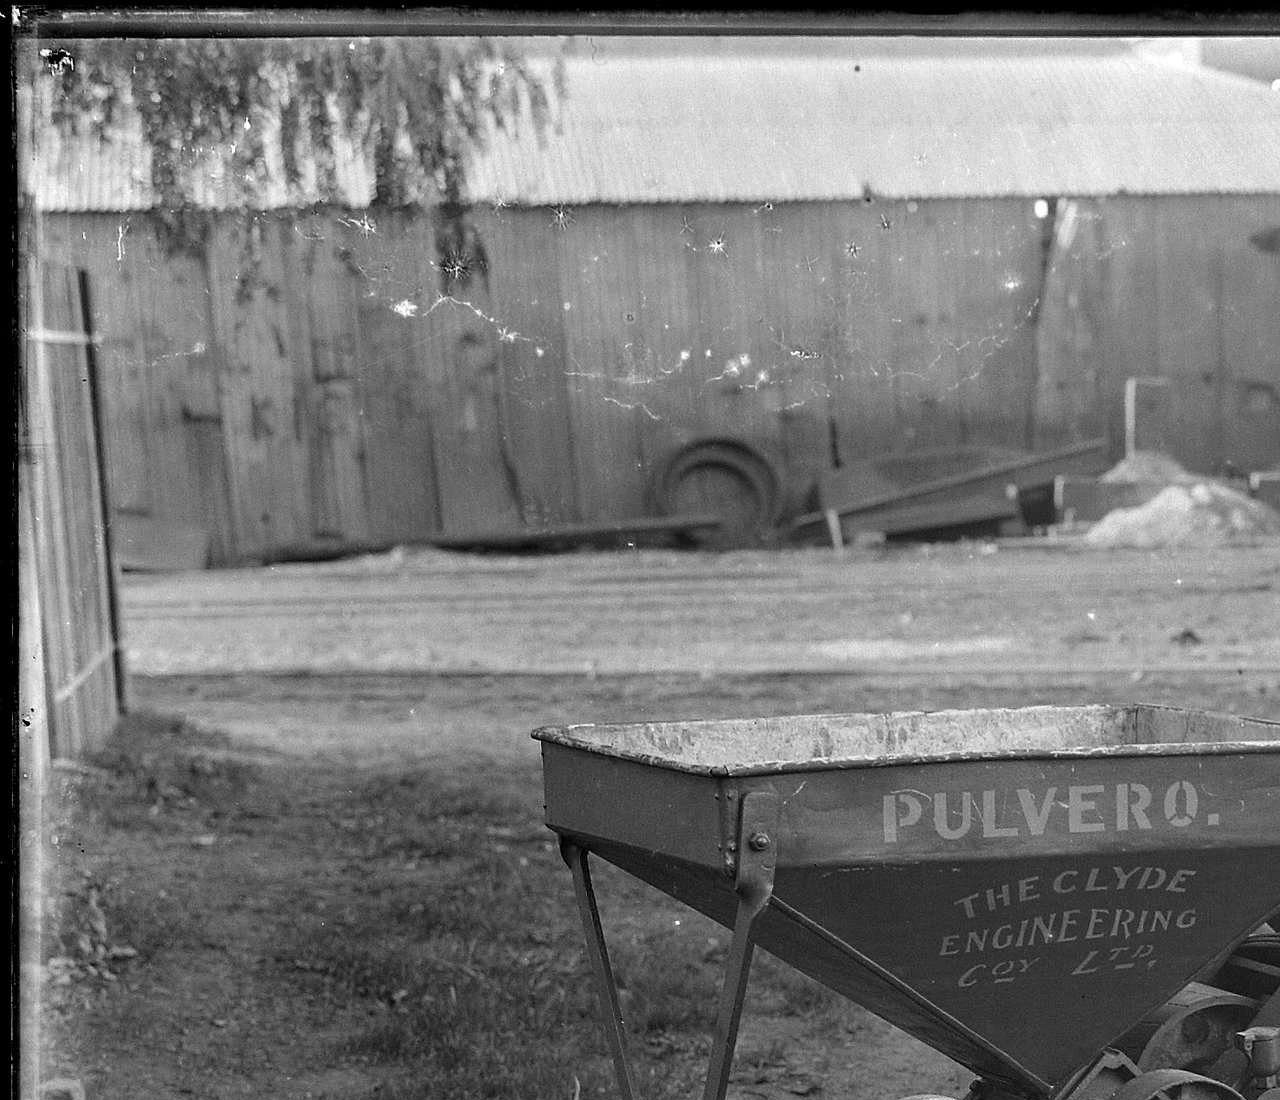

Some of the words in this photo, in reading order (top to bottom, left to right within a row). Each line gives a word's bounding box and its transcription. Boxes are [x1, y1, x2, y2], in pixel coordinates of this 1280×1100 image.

[882, 780, 1221, 844] PULVERO.
[953, 876, 1042, 920] THE
[1052, 865, 1198, 895] CLYDE
[938, 908, 1199, 958] ENGINEERING
